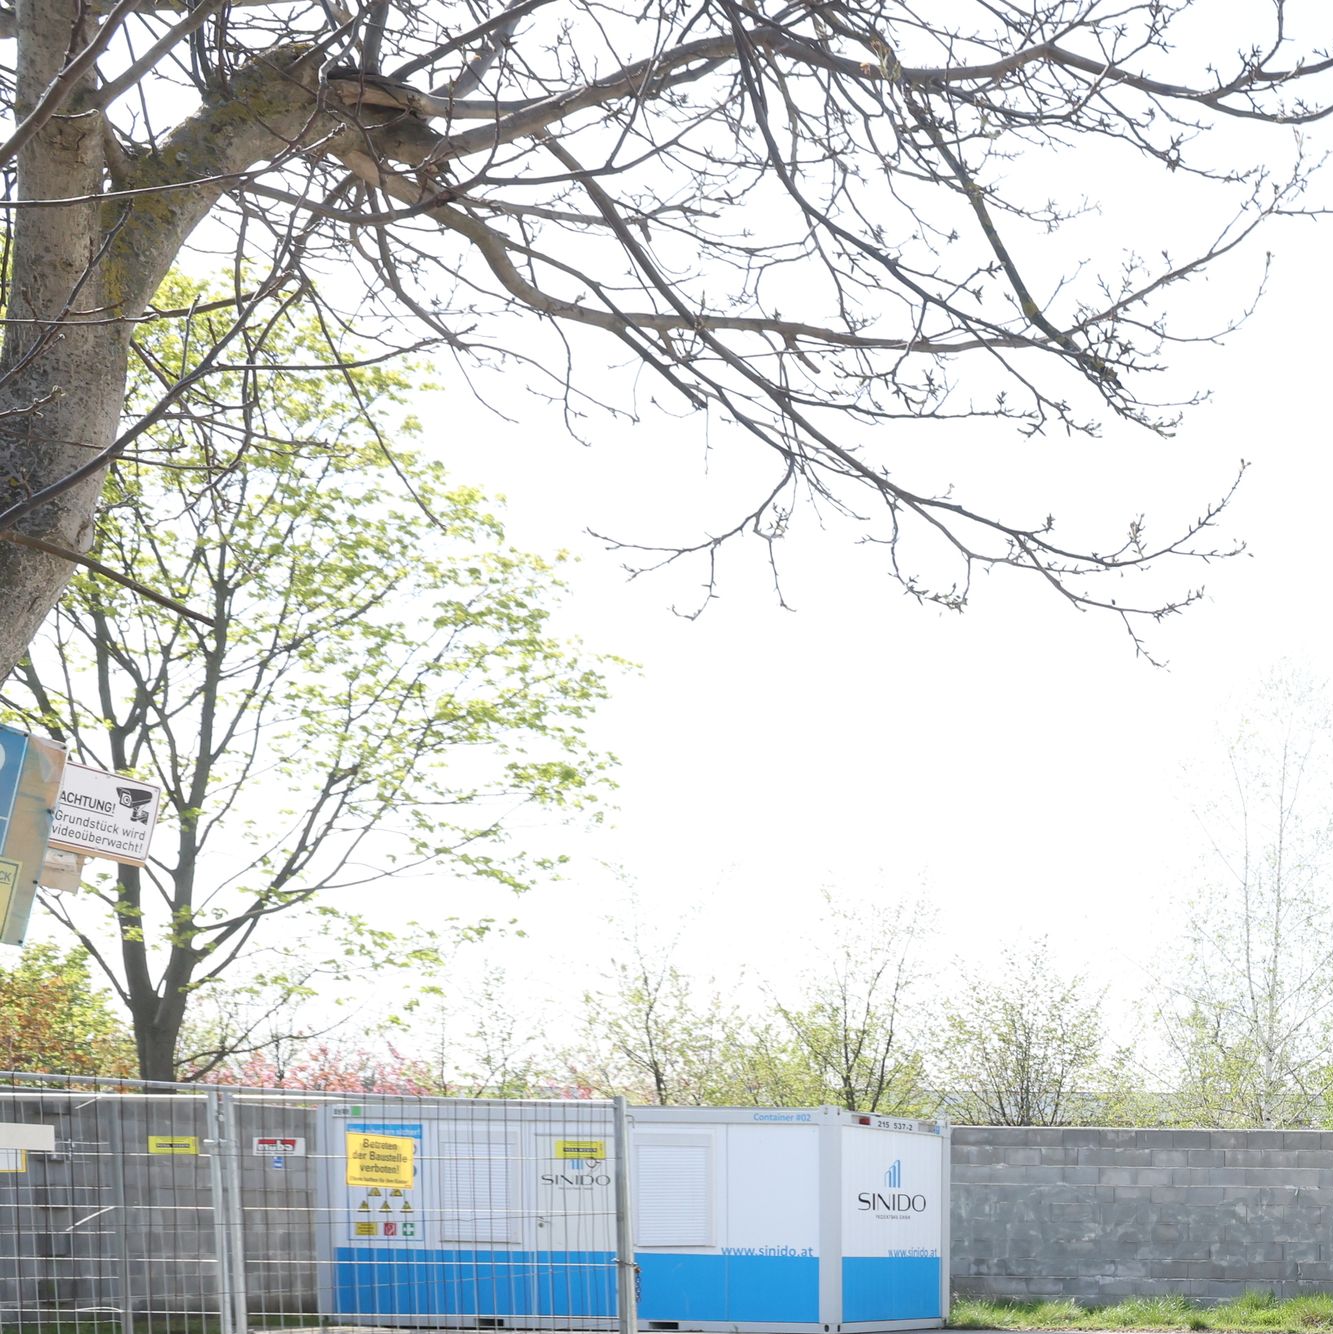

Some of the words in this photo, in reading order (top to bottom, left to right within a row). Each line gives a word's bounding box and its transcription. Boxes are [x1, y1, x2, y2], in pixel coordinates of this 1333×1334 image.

[60, 790, 117, 814] ACHTUNG!
[55, 809, 119, 835] Grundstück
[122, 827, 146, 841] wird
[52, 824, 144, 853] videoüberwacht!
[753, 1113, 794, 1121] Container
[878, 1121, 889, 1129] 215
[363, 1138, 398, 1150] Betreten
[352, 1151, 367, 1160] der
[369, 1151, 408, 1163] Baustelle
[360, 1164, 400, 1174] verboten!
[541, 1174, 611, 1186] SINIDO
[857, 1192, 927, 1213] SINIDO
[721, 1245, 813, 1257] www.sinido.at
[888, 1247, 937, 1258] www.sinido.at
